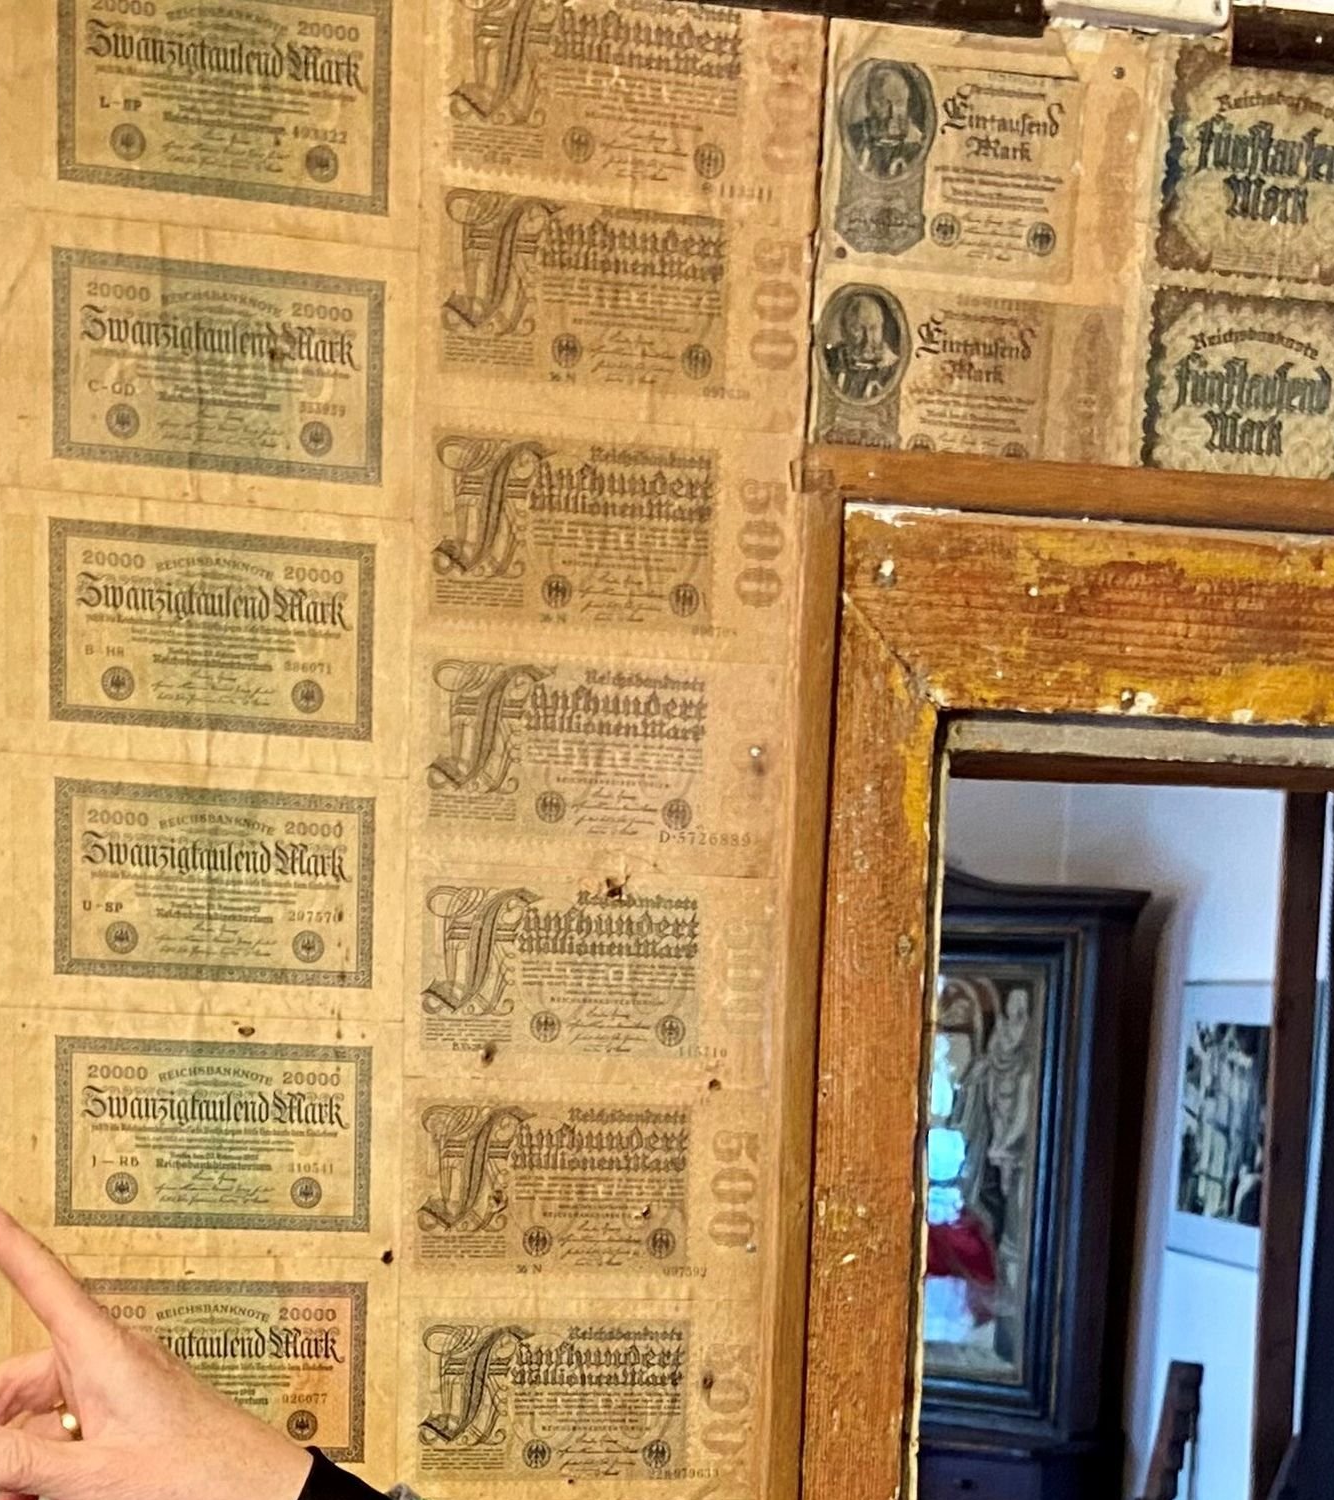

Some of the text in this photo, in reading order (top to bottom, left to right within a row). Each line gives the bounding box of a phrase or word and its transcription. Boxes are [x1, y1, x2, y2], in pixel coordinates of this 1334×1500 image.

[297, 20, 359, 42] 20000
[287, 42, 367, 94] Mark
[291, 302, 353, 322] 20000
[750, 238, 801, 370] 500
[282, 323, 361, 371] Mark
[283, 566, 344, 585] 20000
[274, 585, 353, 631] Mark
[285, 821, 344, 838] 20000
[275, 845, 351, 882] Mark
[158, 1066, 273, 1086] REICHSBANKNOTE
[283, 1072, 340, 1086] 20000
[273, 1091, 349, 1130] Mark
[708, 1129, 759, 1247] 500
[156, 1303, 270, 1322] REICHSBANKNOTE
[279, 1307, 336, 1321] 20000
[270, 1326, 345, 1363] Mark
